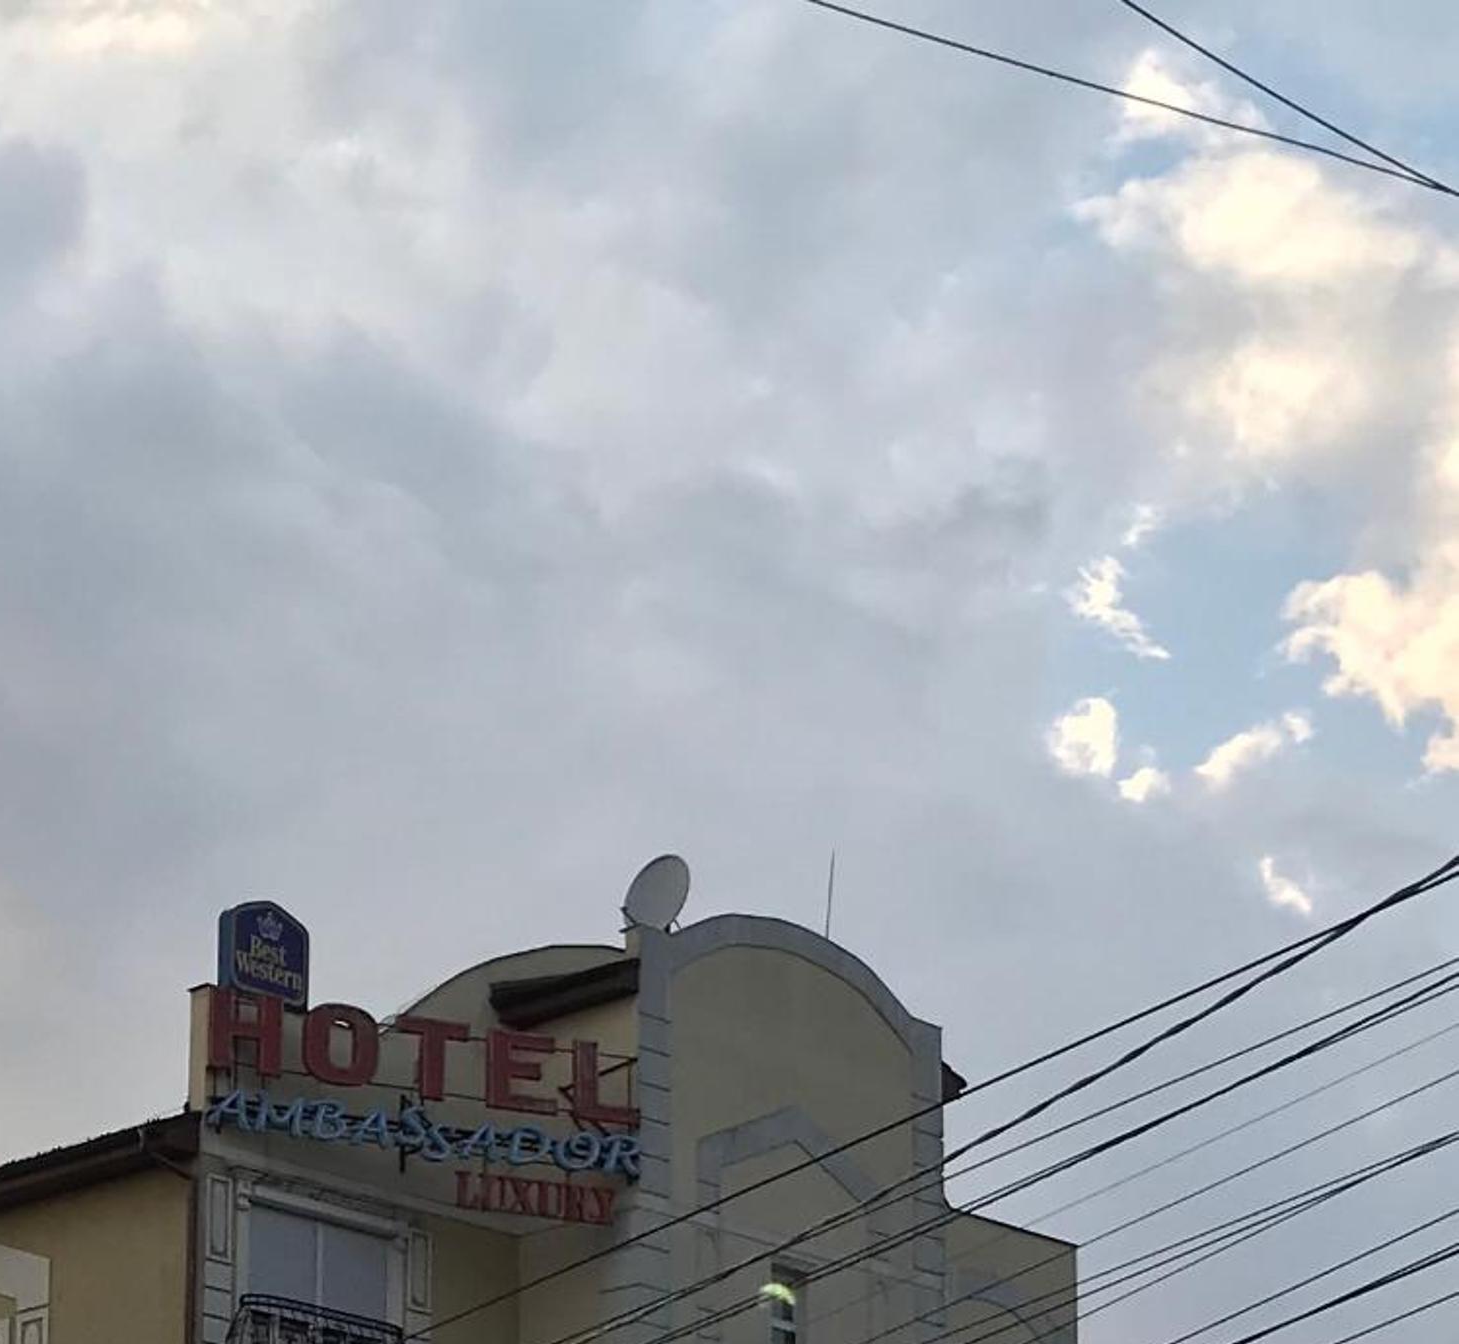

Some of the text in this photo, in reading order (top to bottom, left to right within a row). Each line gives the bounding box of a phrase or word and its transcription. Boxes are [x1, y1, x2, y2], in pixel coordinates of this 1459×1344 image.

[236, 950, 302, 992] Western
[250, 934, 286, 967] Best
[208, 986, 640, 1126] HOTEL
[207, 1089, 640, 1180] AMBASSADOR
[454, 1170, 616, 1226] LUXURY
